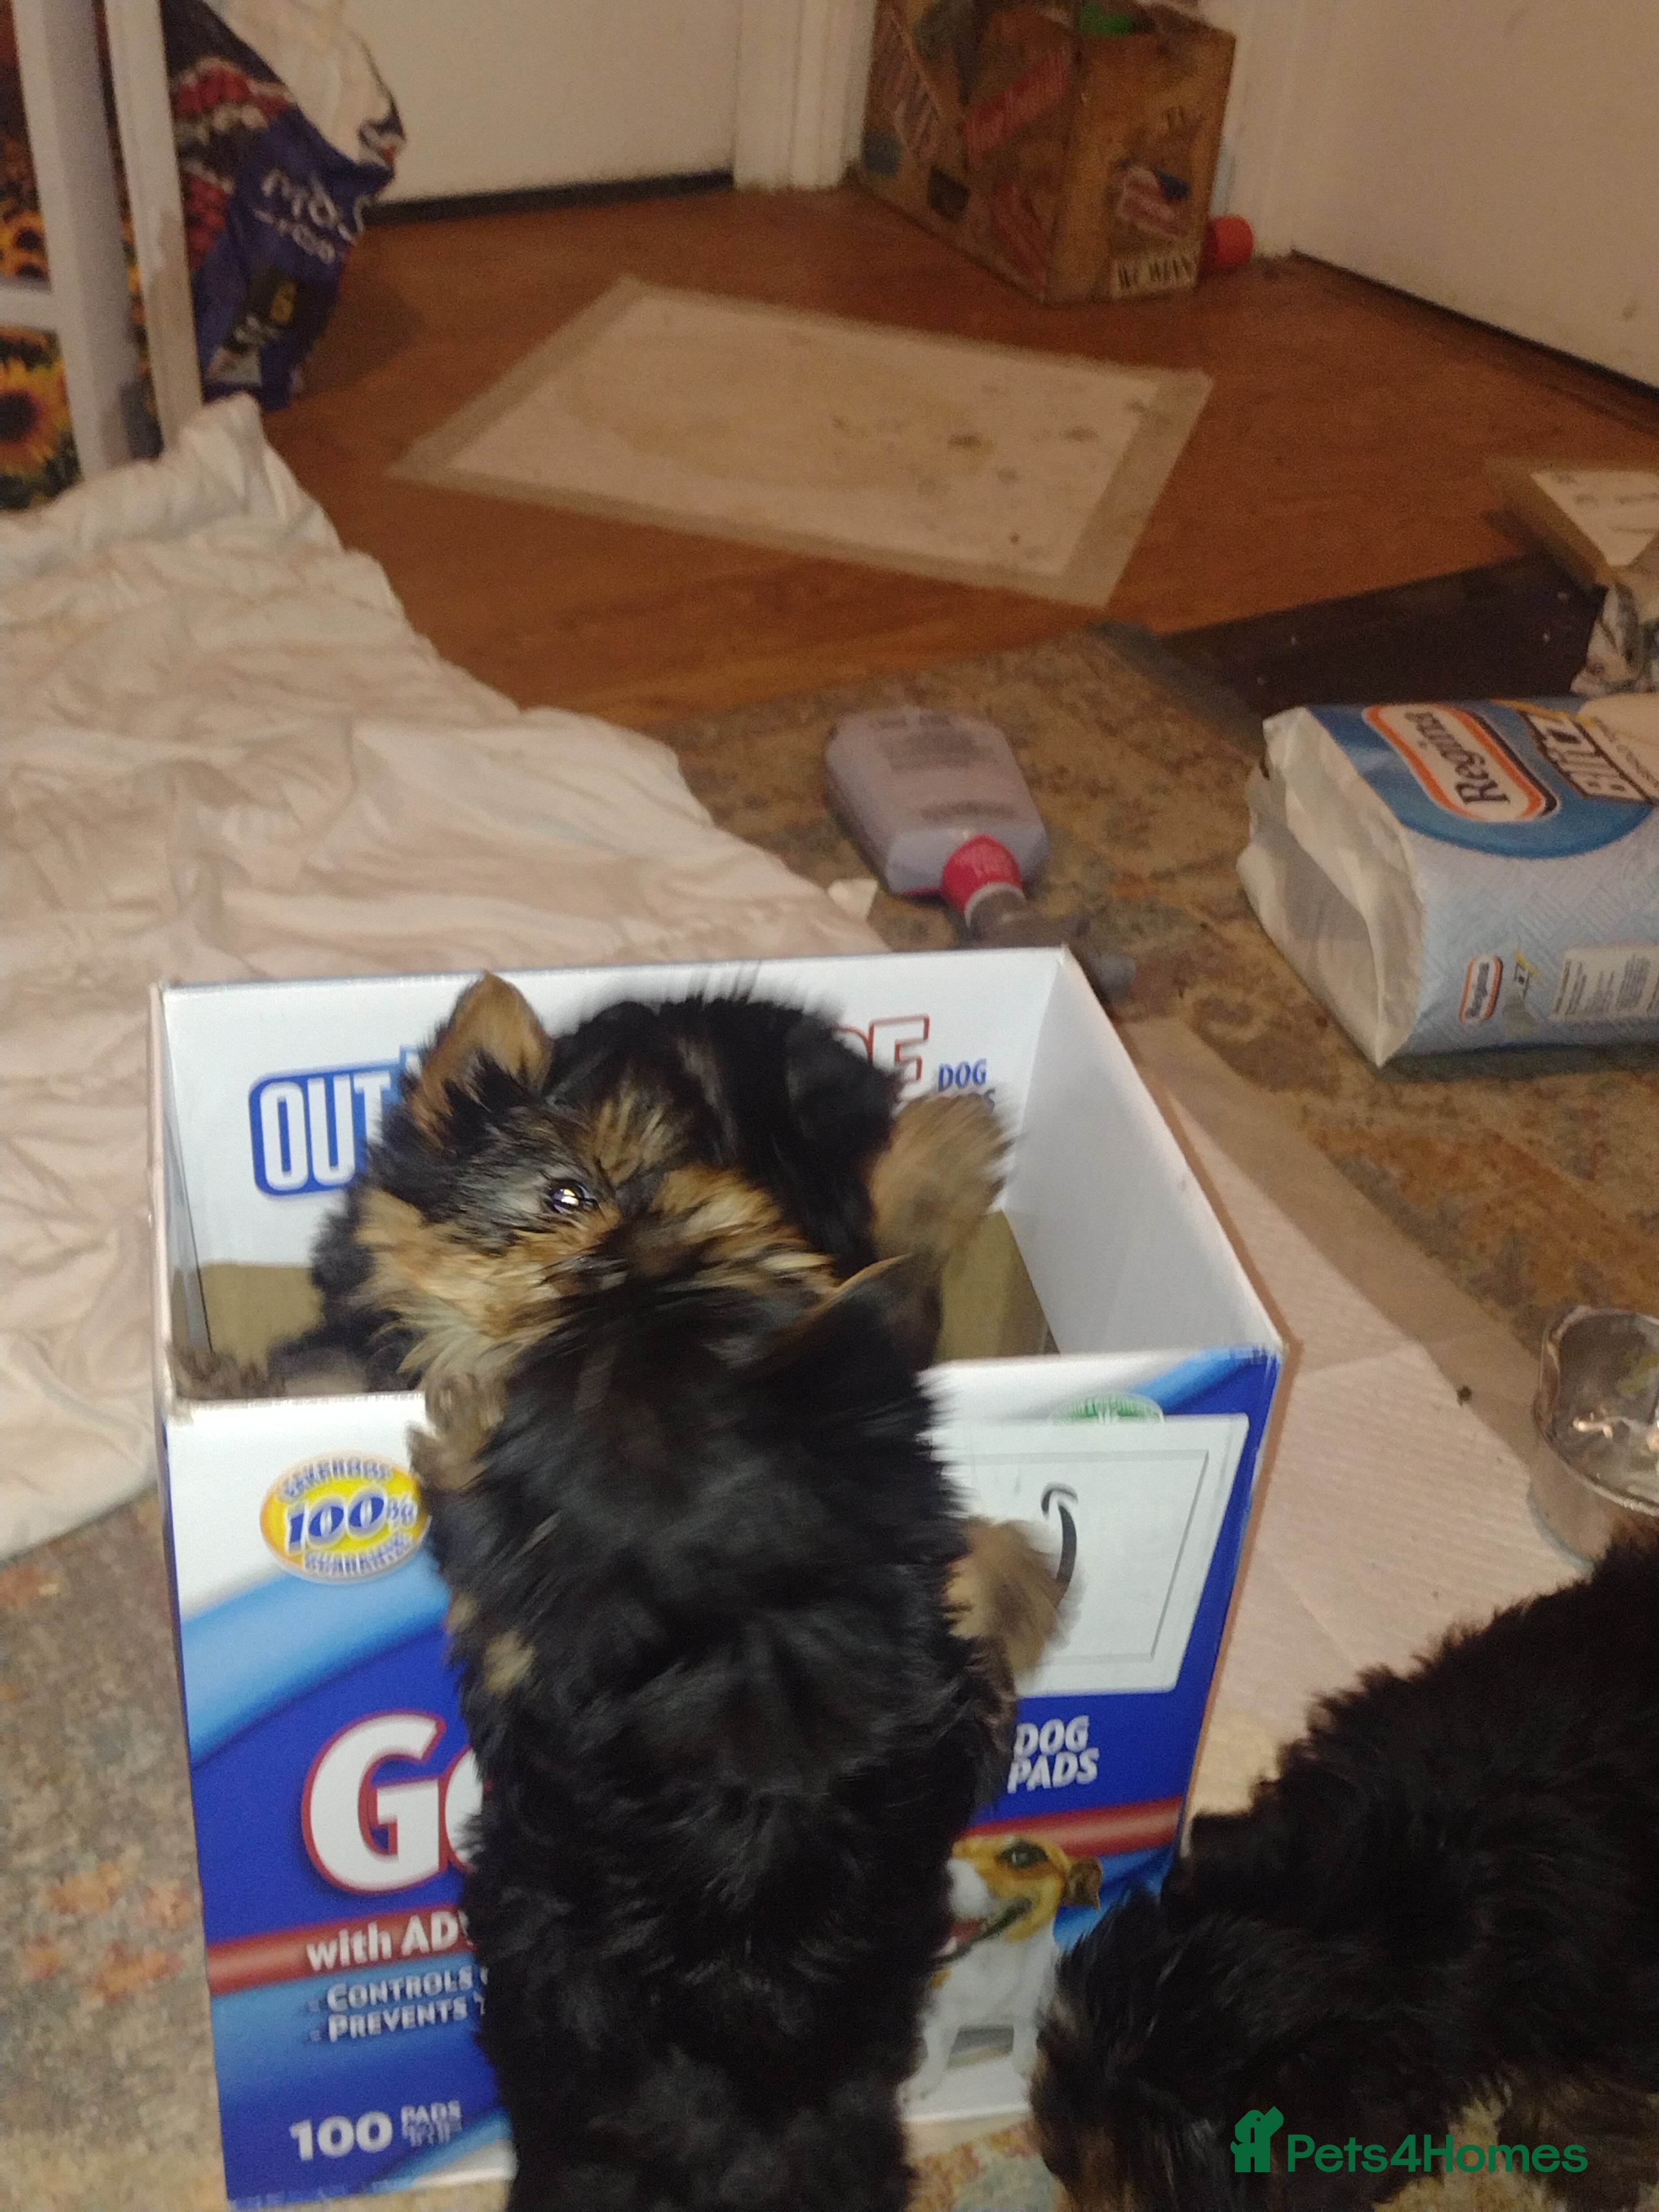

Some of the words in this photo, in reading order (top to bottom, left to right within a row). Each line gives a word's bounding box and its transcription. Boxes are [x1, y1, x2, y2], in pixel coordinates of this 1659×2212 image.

[1405, 712, 1511, 804] Regina
[938, 1058, 987, 1092] DOG
[250, 1045, 421, 1196] OUT
[1014, 1715, 1089, 1760] DOG
[1008, 1748, 1099, 1793] PADS
[307, 1922, 392, 1972] with
[327, 1964, 473, 2012] CONTROLS
[328, 1996, 468, 2042] PREVENTS
[288, 2111, 393, 2162] 100
